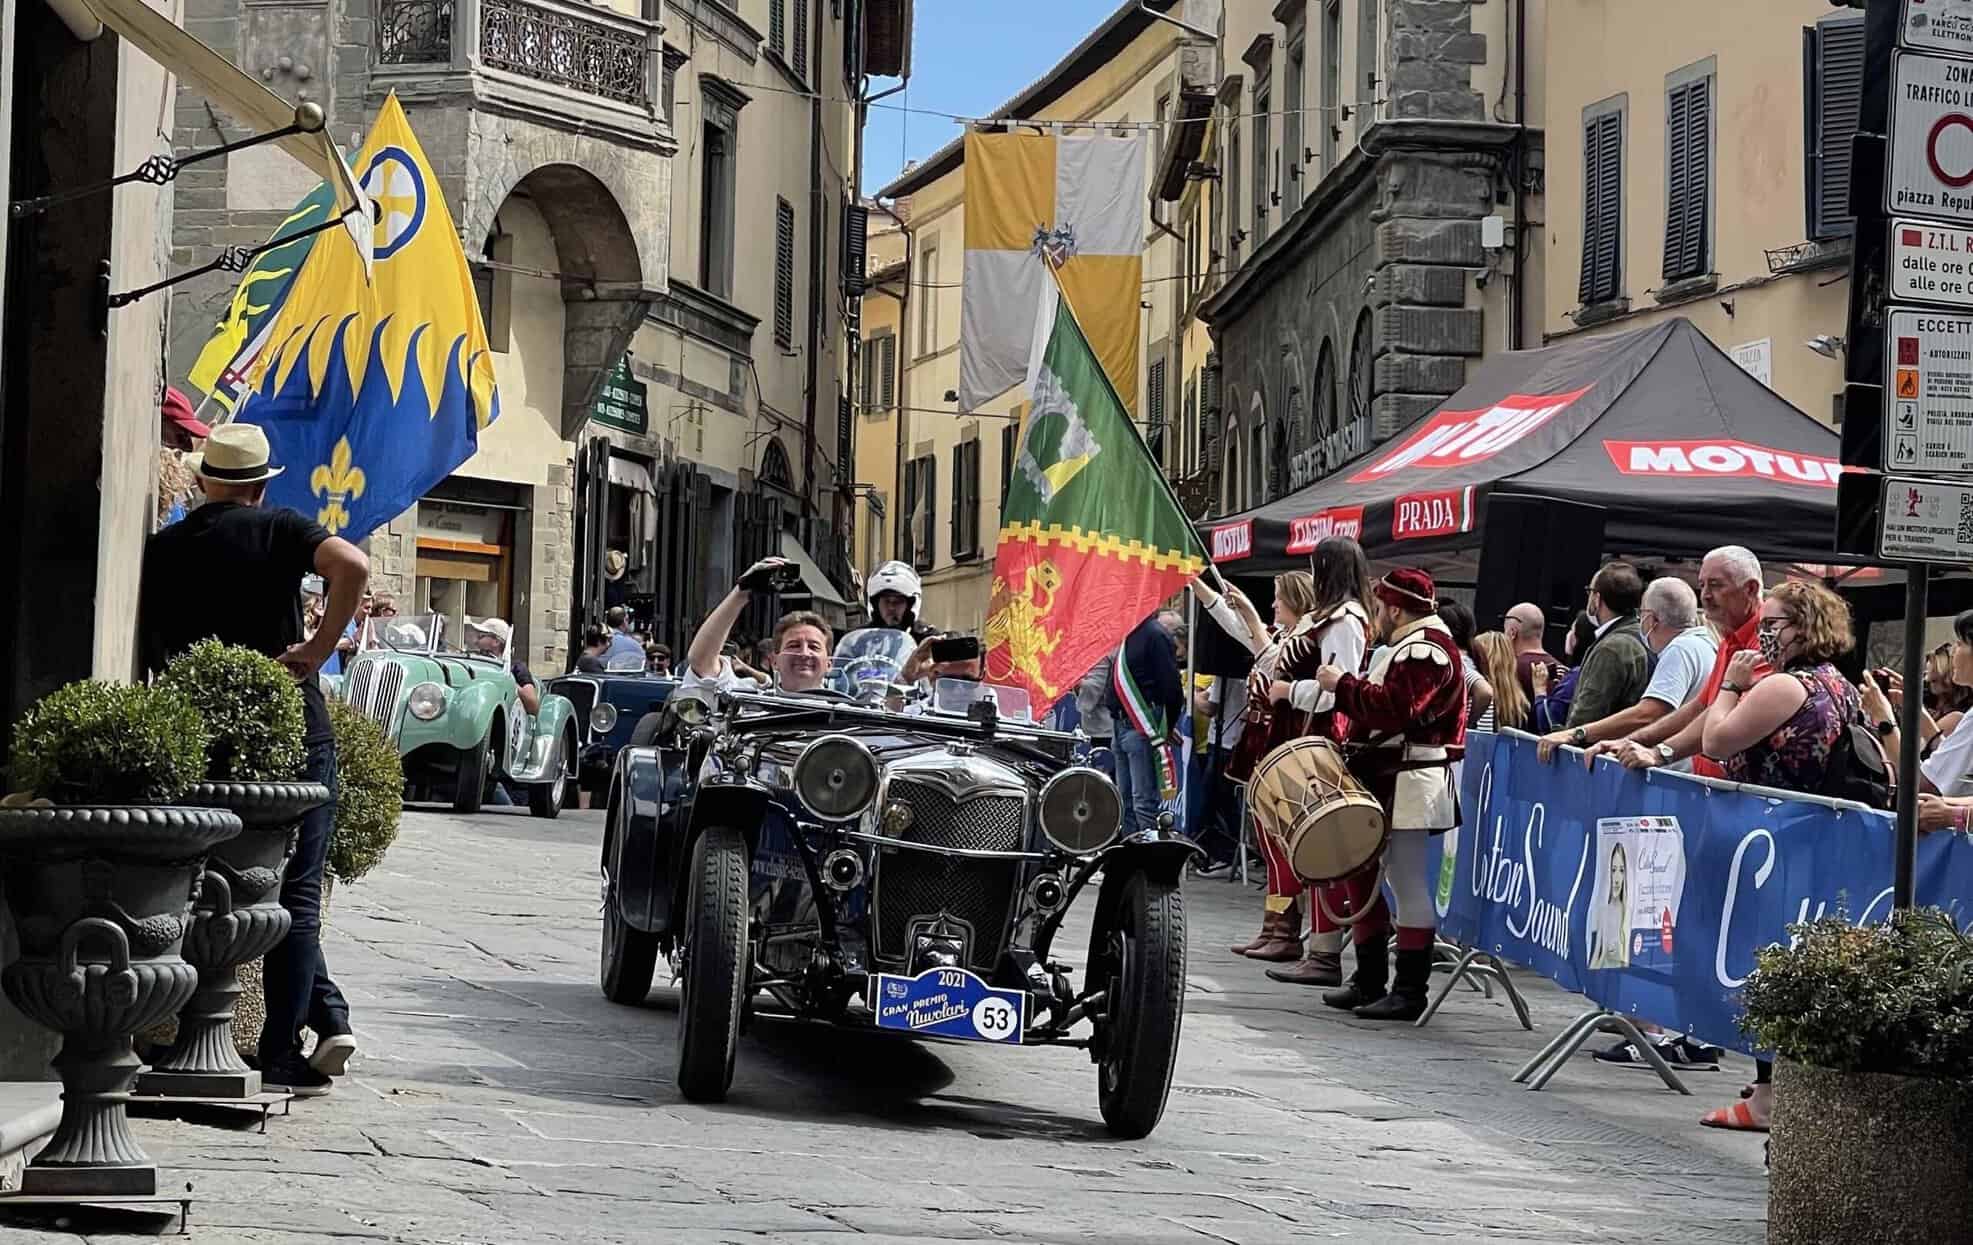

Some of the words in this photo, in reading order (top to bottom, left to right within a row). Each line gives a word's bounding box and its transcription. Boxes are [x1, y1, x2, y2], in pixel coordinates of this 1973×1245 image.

[1906, 84, 1960, 105] TRAFFICO
[1897, 187, 1934, 206] piazza
[1928, 232, 1959, 251] Z.T.L.
[1902, 256, 1937, 271] dalle
[1942, 262, 1963, 274] ore
[1910, 276, 1936, 290] alle
[1940, 281, 1962, 294] ore
[1918, 319, 1972, 334] ECCETT
[1398, 497, 1454, 534] PRADA
[1213, 524, 1250, 560] MOTUL
[938, 970, 966, 988] 2021
[882, 1004, 909, 1017] GRAN
[913, 993, 948, 1010] PREMIO
[906, 1000, 970, 1029] Nuvolari
[983, 1006, 1009, 1031] 53
